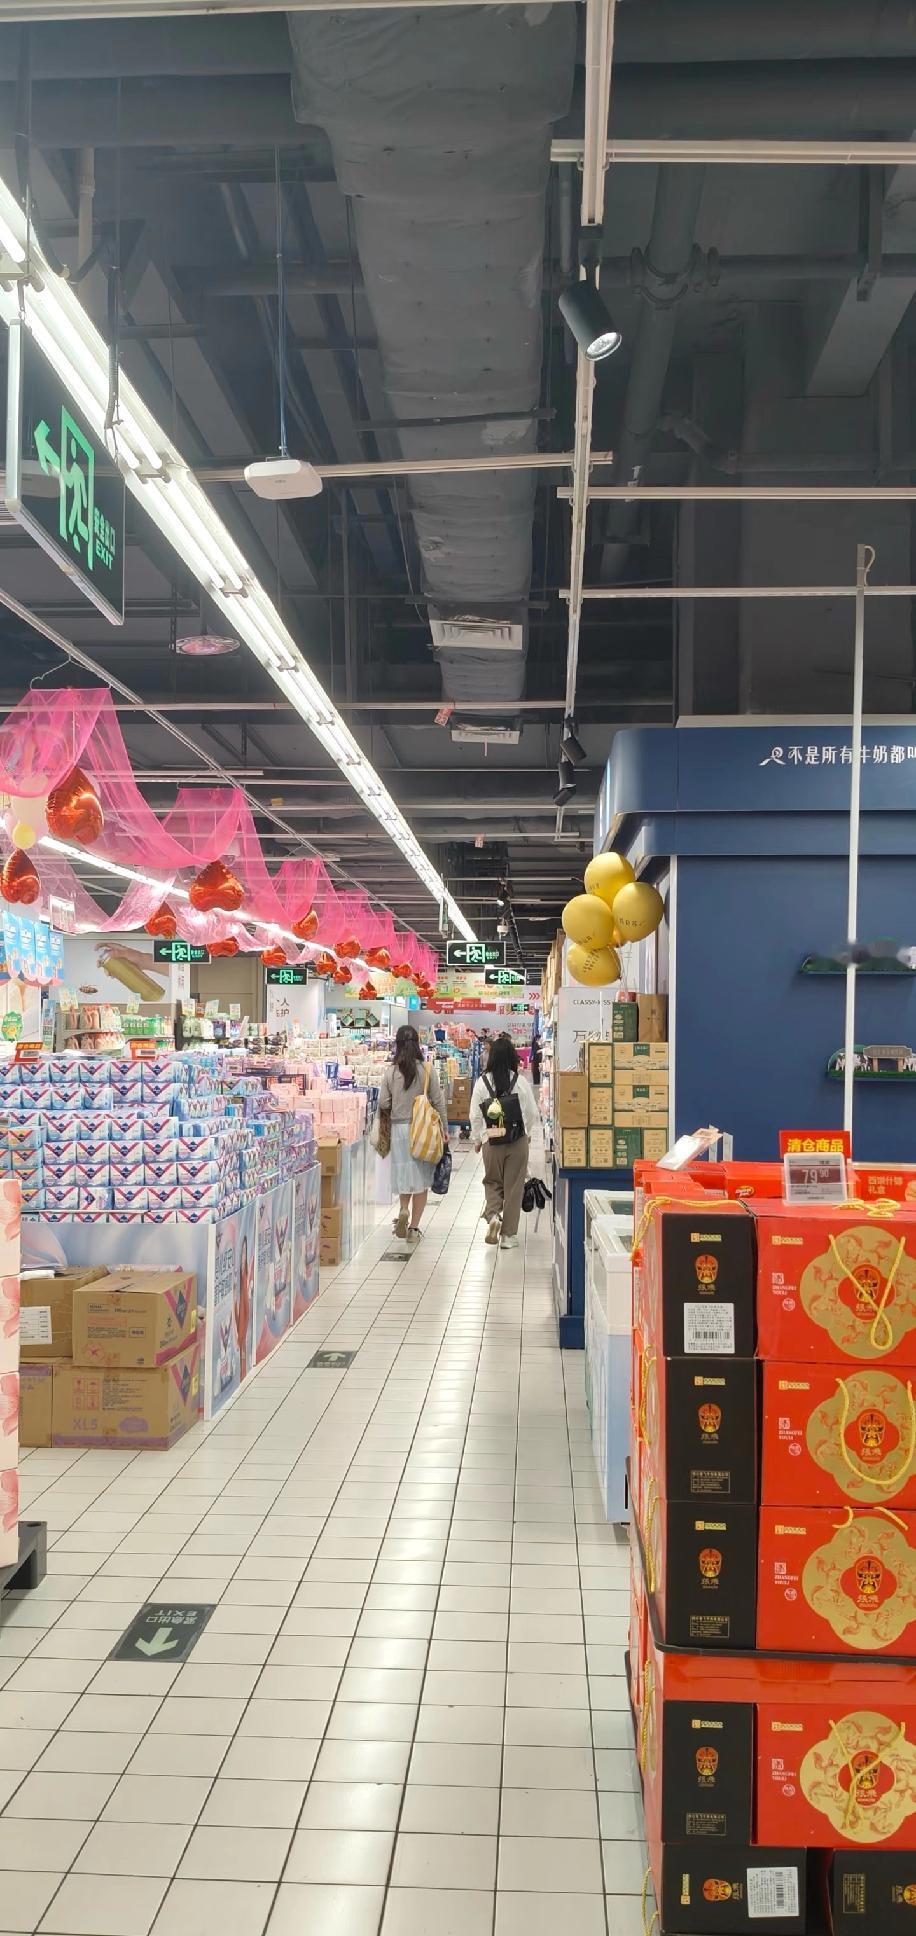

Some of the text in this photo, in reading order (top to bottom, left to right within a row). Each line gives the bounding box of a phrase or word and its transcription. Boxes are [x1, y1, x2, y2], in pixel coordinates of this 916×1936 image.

[95, 538, 114, 571] EXIT
[787, 1138, 844, 1153] 清仓商品
[154, 1609, 198, 1617] EXIT
